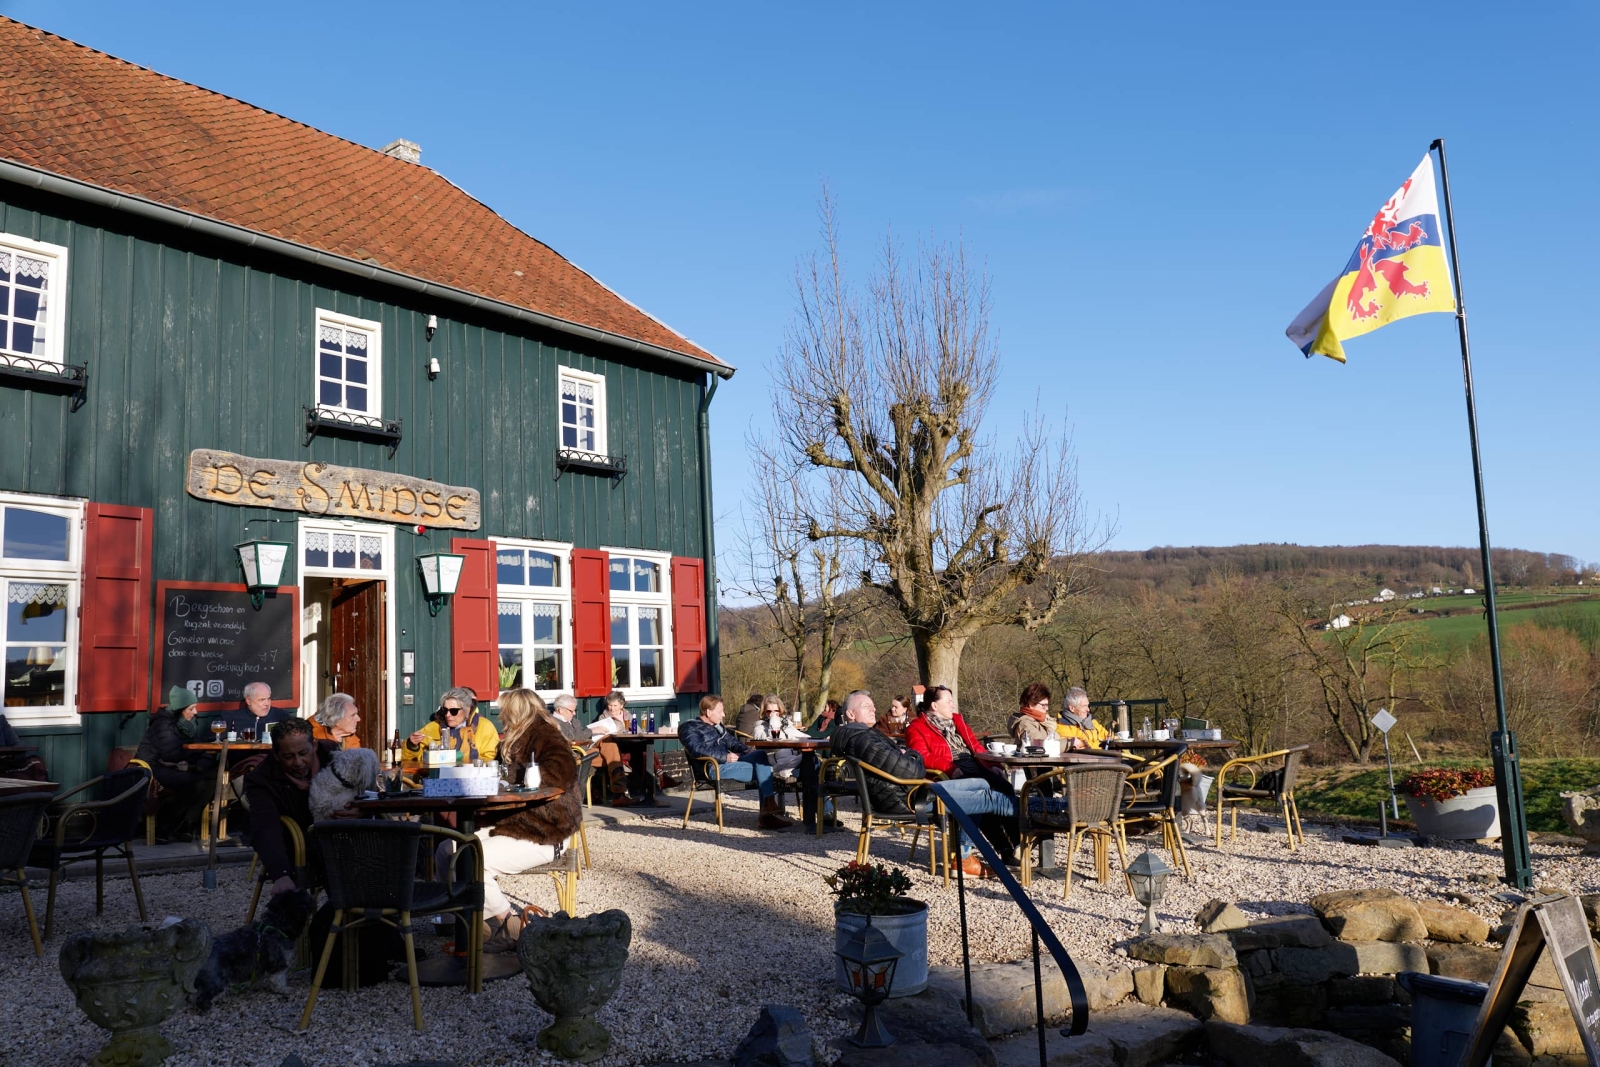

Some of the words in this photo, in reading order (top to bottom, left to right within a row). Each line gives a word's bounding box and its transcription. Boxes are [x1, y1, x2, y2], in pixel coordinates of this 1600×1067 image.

[184, 619, 212, 631] Rugzak
[167, 630, 206, 646] Genieten
[207, 637, 219, 645] van
[219, 638, 235, 646] onze
